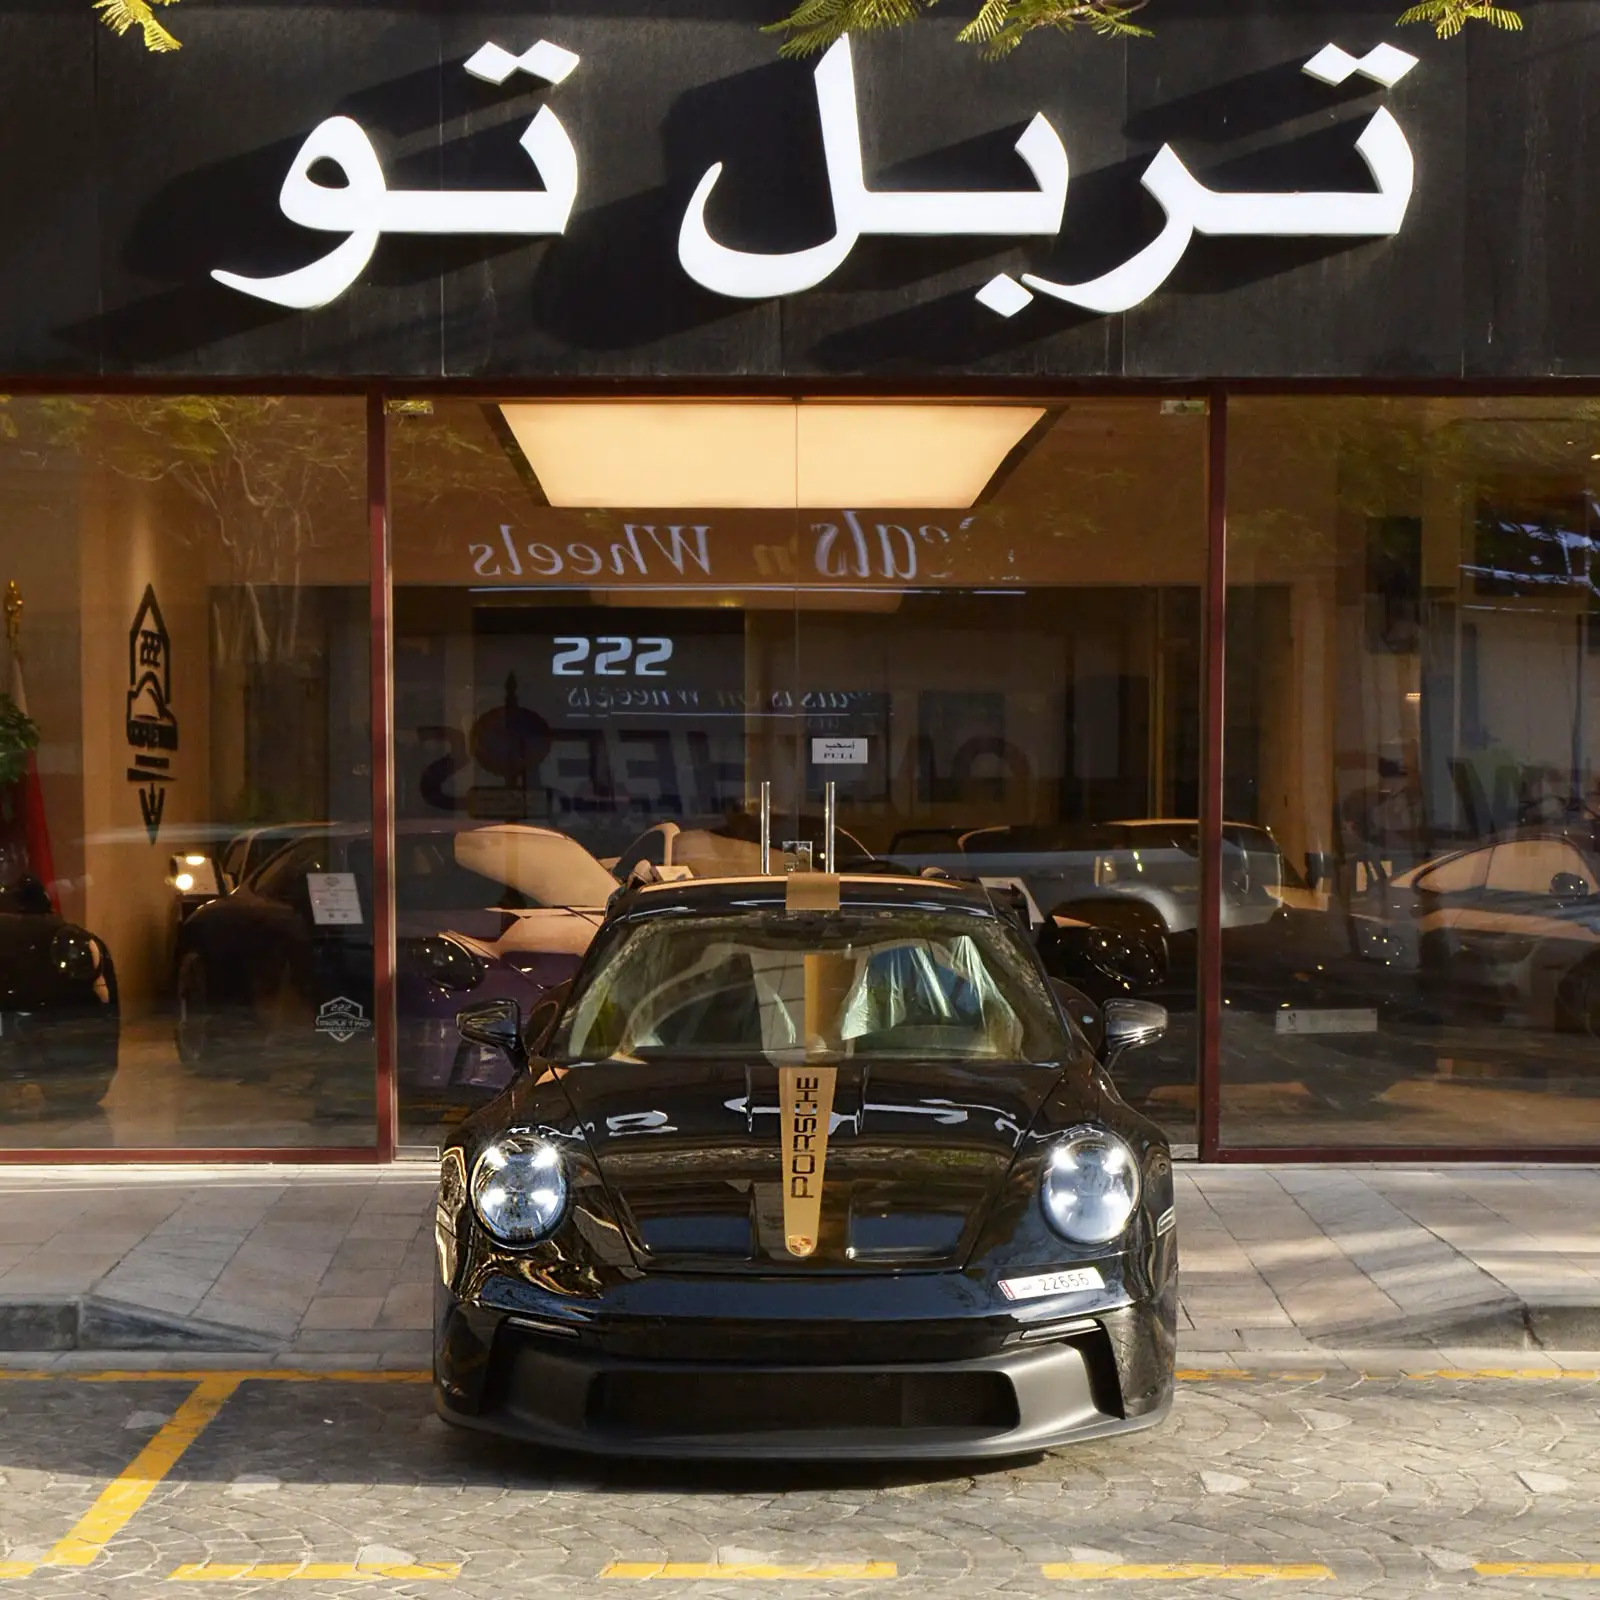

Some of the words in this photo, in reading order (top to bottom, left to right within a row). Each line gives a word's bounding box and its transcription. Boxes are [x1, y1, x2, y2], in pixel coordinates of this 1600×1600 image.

[211, 40, 581, 310] تو
[678, 34, 1420, 318] تربل
[552, 637, 674, 676] 222
[790, 1076, 819, 1199] PORSCHE
